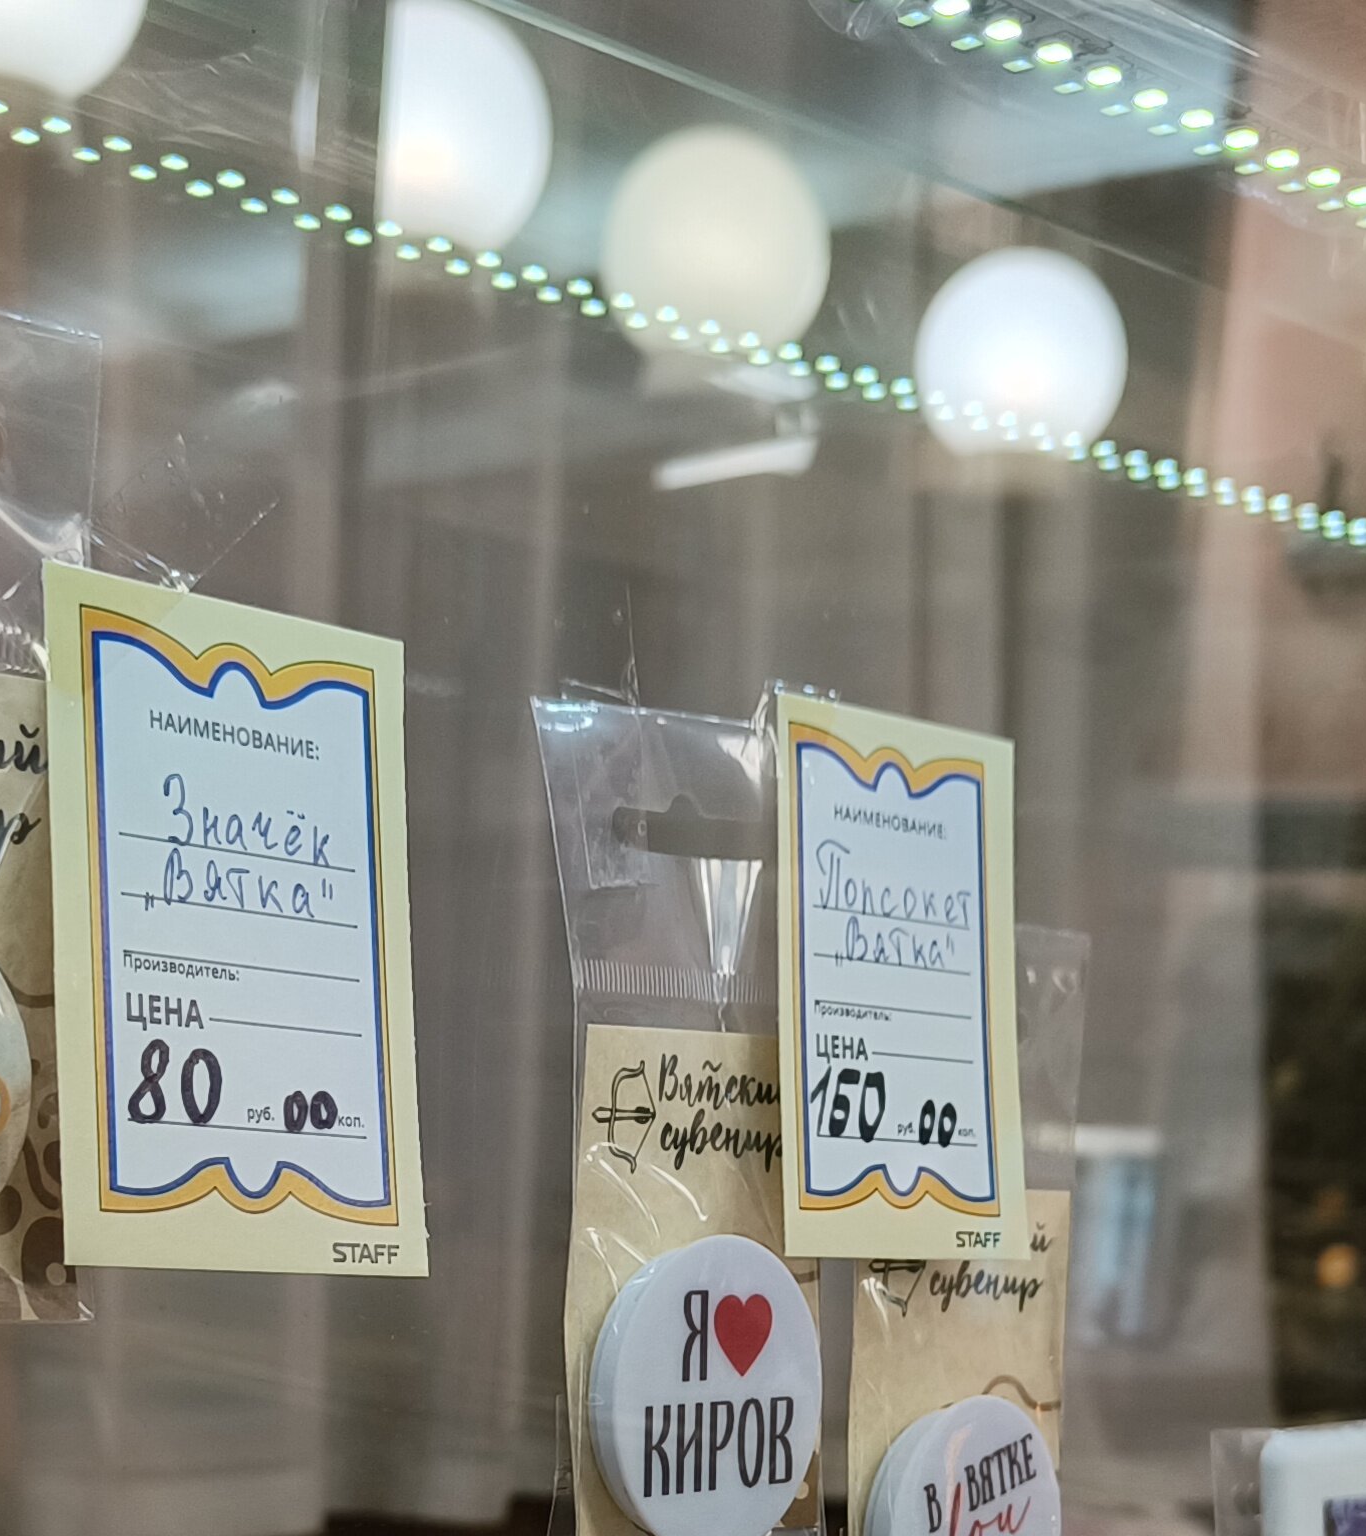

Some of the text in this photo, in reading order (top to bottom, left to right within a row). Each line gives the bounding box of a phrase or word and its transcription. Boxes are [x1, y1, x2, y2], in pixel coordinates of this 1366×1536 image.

[150, 709, 320, 761] НАИМЕНОВАНИЕ:
[163, 773, 331, 867] Значёк
[834, 804, 948, 841] НАИМЕНОВАНИЕ:
[123, 953, 241, 983] Производитель:
[125, 991, 205, 1032] ЦЕНА
[814, 1001, 893, 1023] Производитель:
[816, 1033, 869, 1064] ЦЕНА
[128, 1038, 366, 1133] 80 руб. 00 коп.
[658, 1053, 780, 1111] Вятски
[918, 1099, 957, 1148] 00
[332, 1241, 400, 1265] STAFF
[955, 1231, 1002, 1249] STAFF
[929, 1260, 1044, 1312] сувенир
[681, 1290, 710, 1382] Я
[643, 1396, 795, 1498] КИРОВ
[923, 1433, 1038, 1534] В ВЯТКЕ
